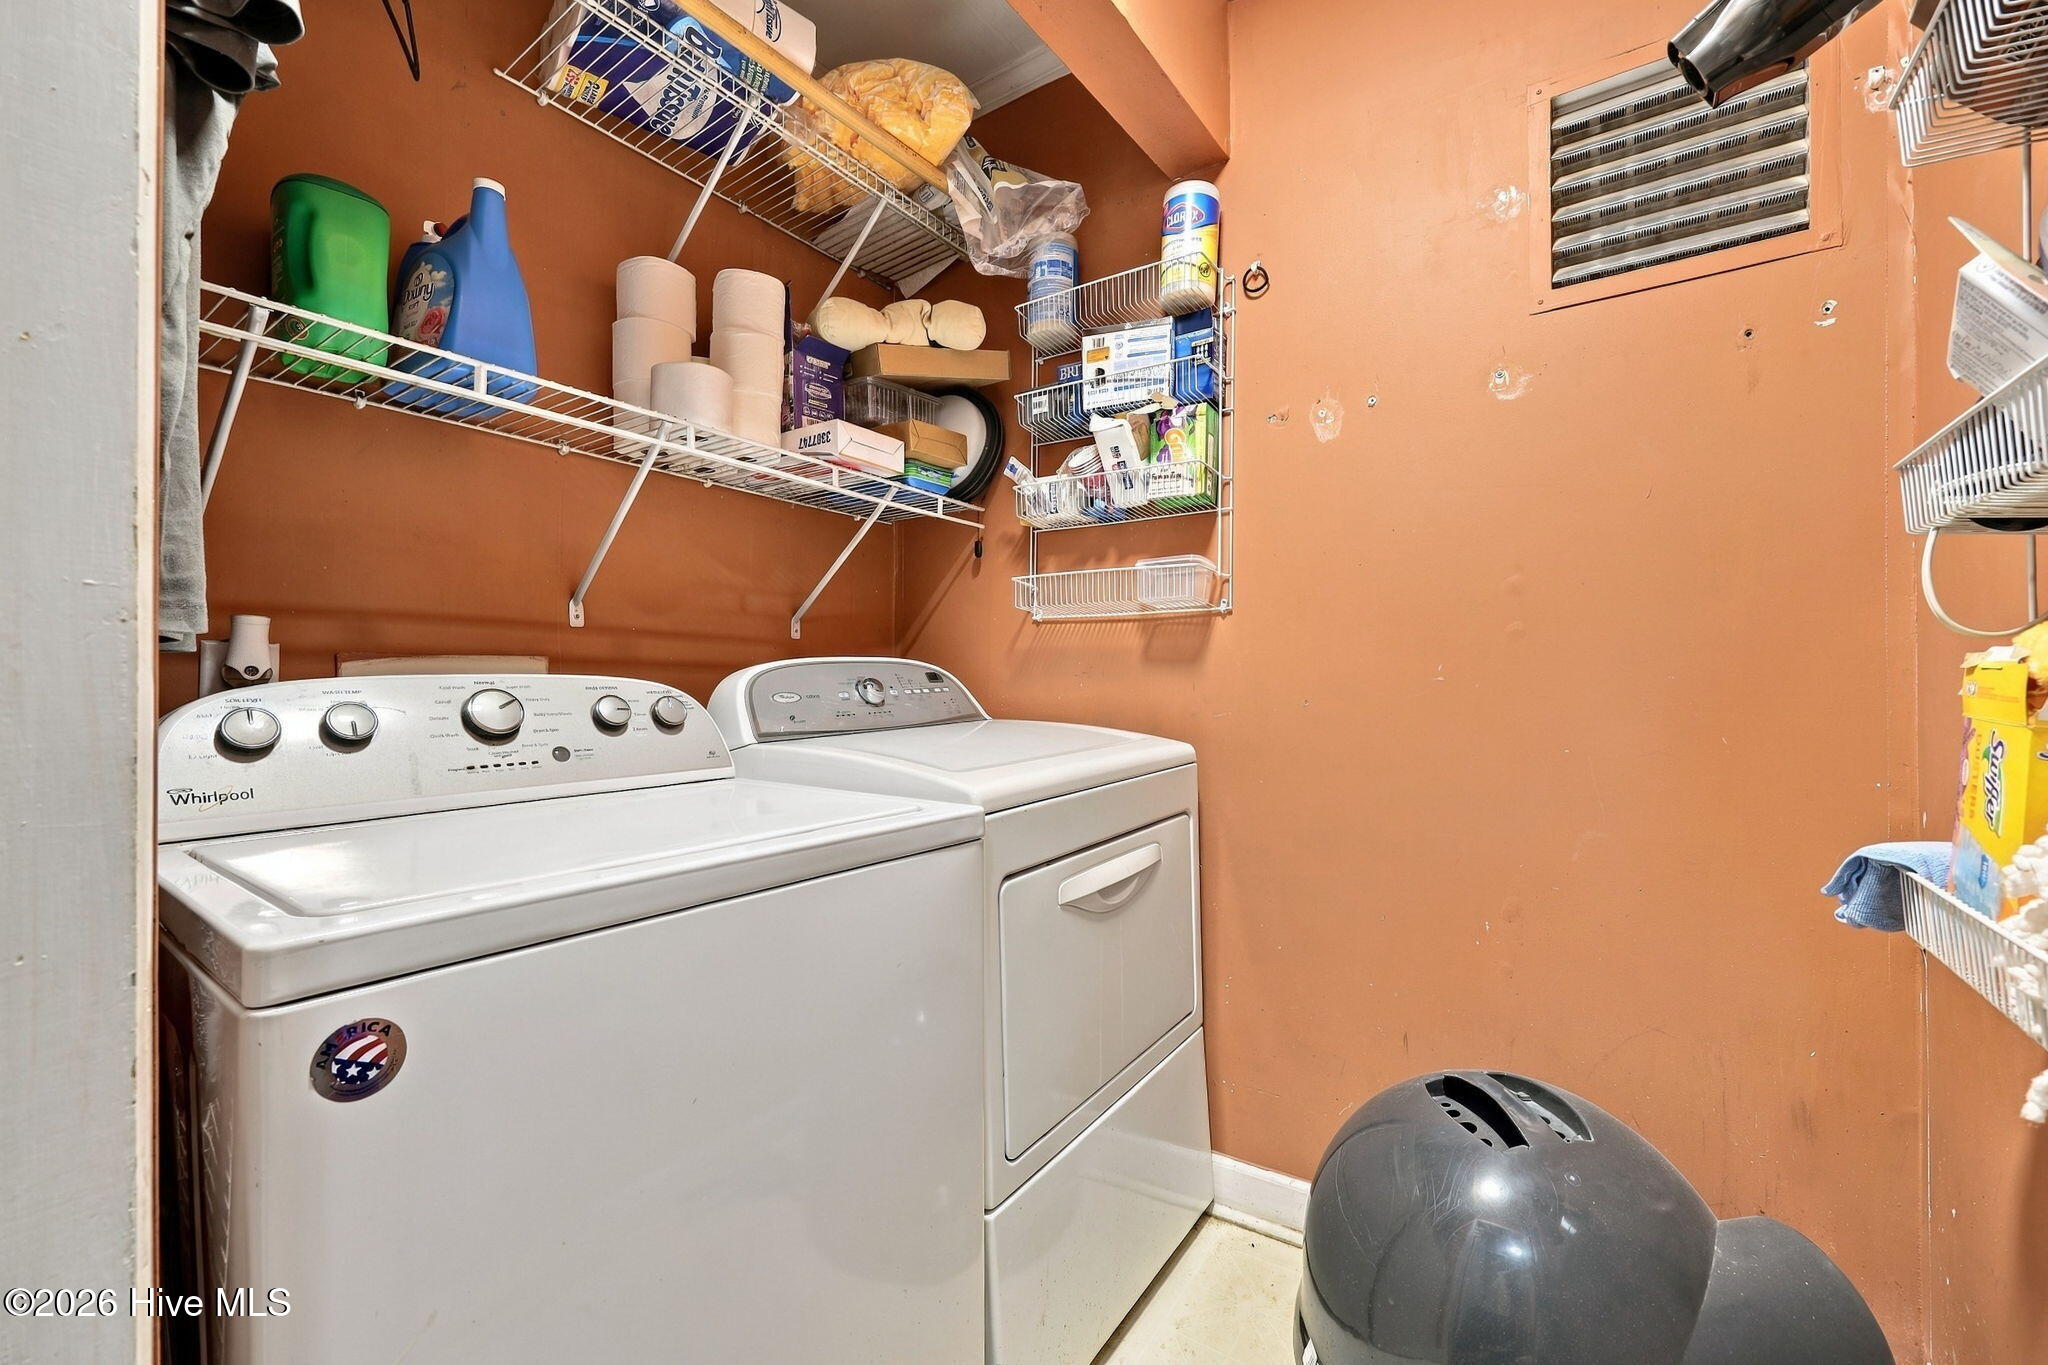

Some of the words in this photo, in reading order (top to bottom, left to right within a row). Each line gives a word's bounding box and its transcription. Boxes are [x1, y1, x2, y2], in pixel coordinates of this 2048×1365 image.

[1059, 363, 1082, 381] BRI
[168, 787, 255, 807] Whirlpool
[1983, 730, 2006, 833] Swiffer
[316, 1021, 393, 1071] AMERICA
